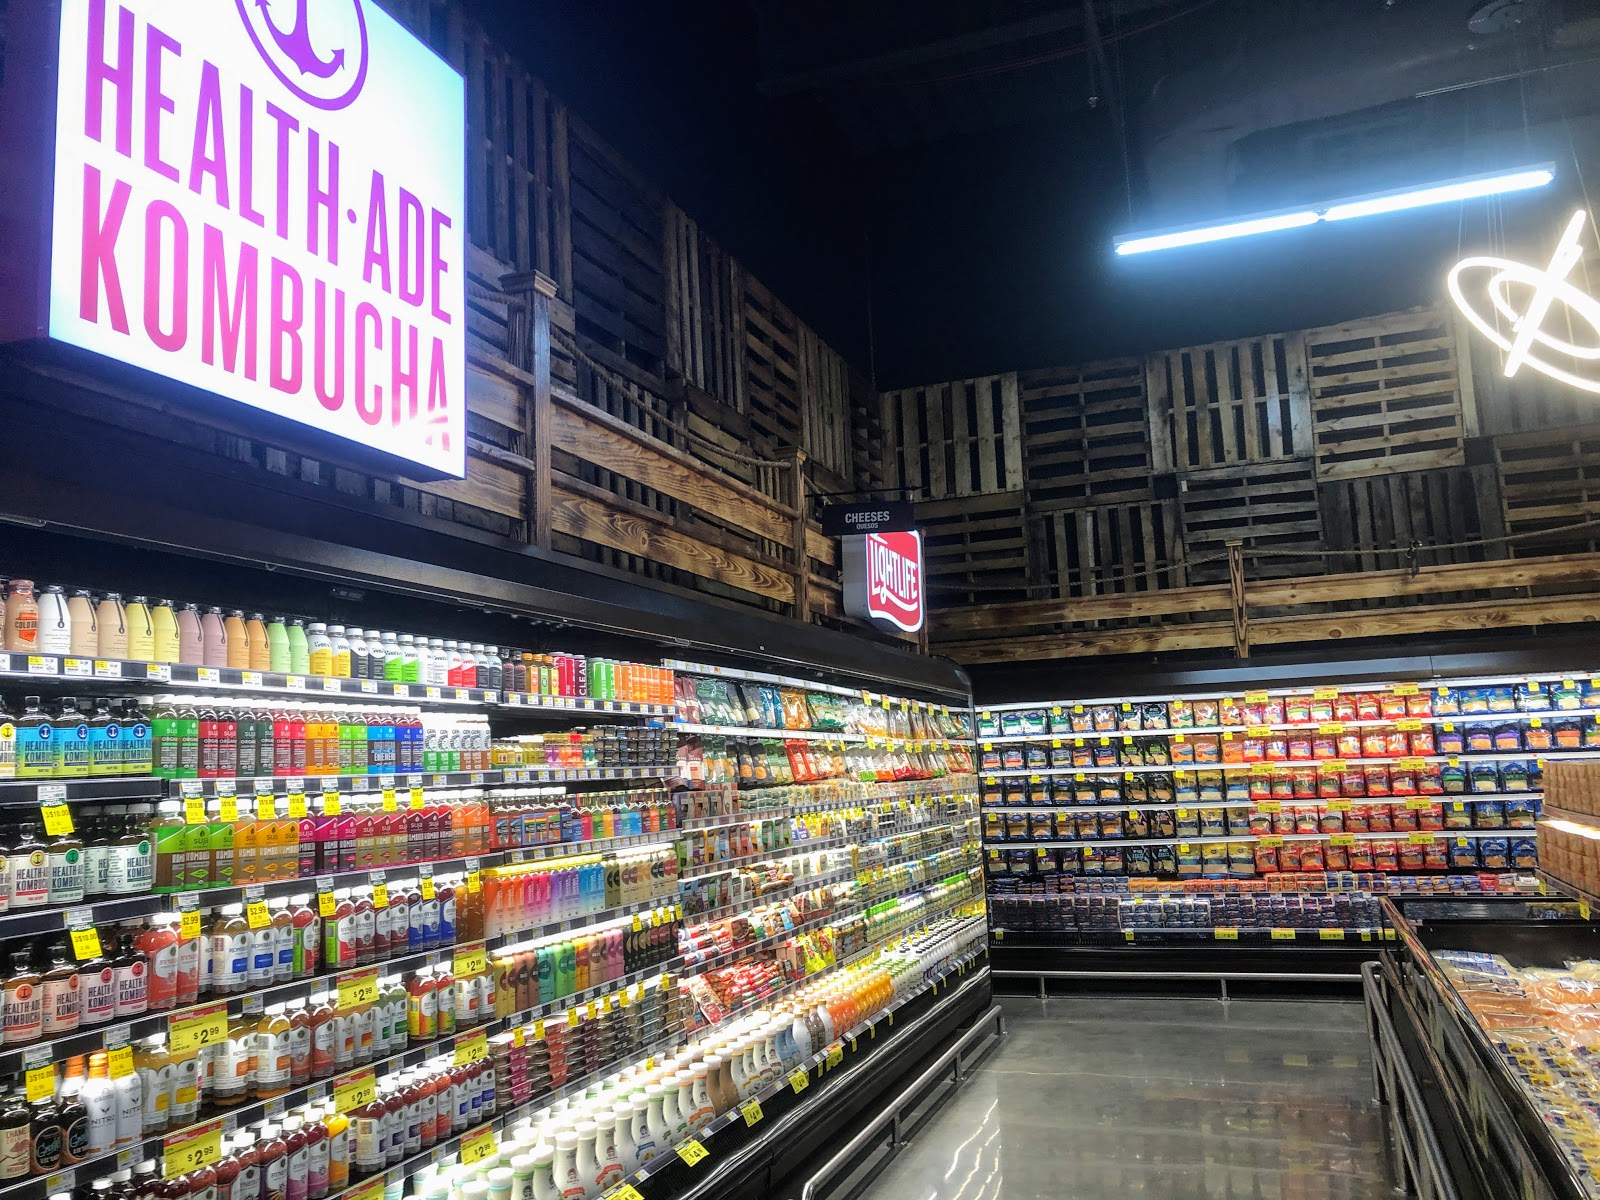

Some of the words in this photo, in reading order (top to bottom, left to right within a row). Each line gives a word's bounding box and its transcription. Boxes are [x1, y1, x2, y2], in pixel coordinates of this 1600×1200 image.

[79, 162, 452, 452] KOMBUCHA
[845, 511, 890, 524] CHEESES
[869, 539, 918, 605] LIGHTLIFE
[15, 621, 31, 629] COLD
[579, 659, 587, 696] CLEAN
[250, 906, 267, 916] $2.99
[182, 915, 199, 926] $2.99
[29, 1069, 54, 1083] 3/$10.00
